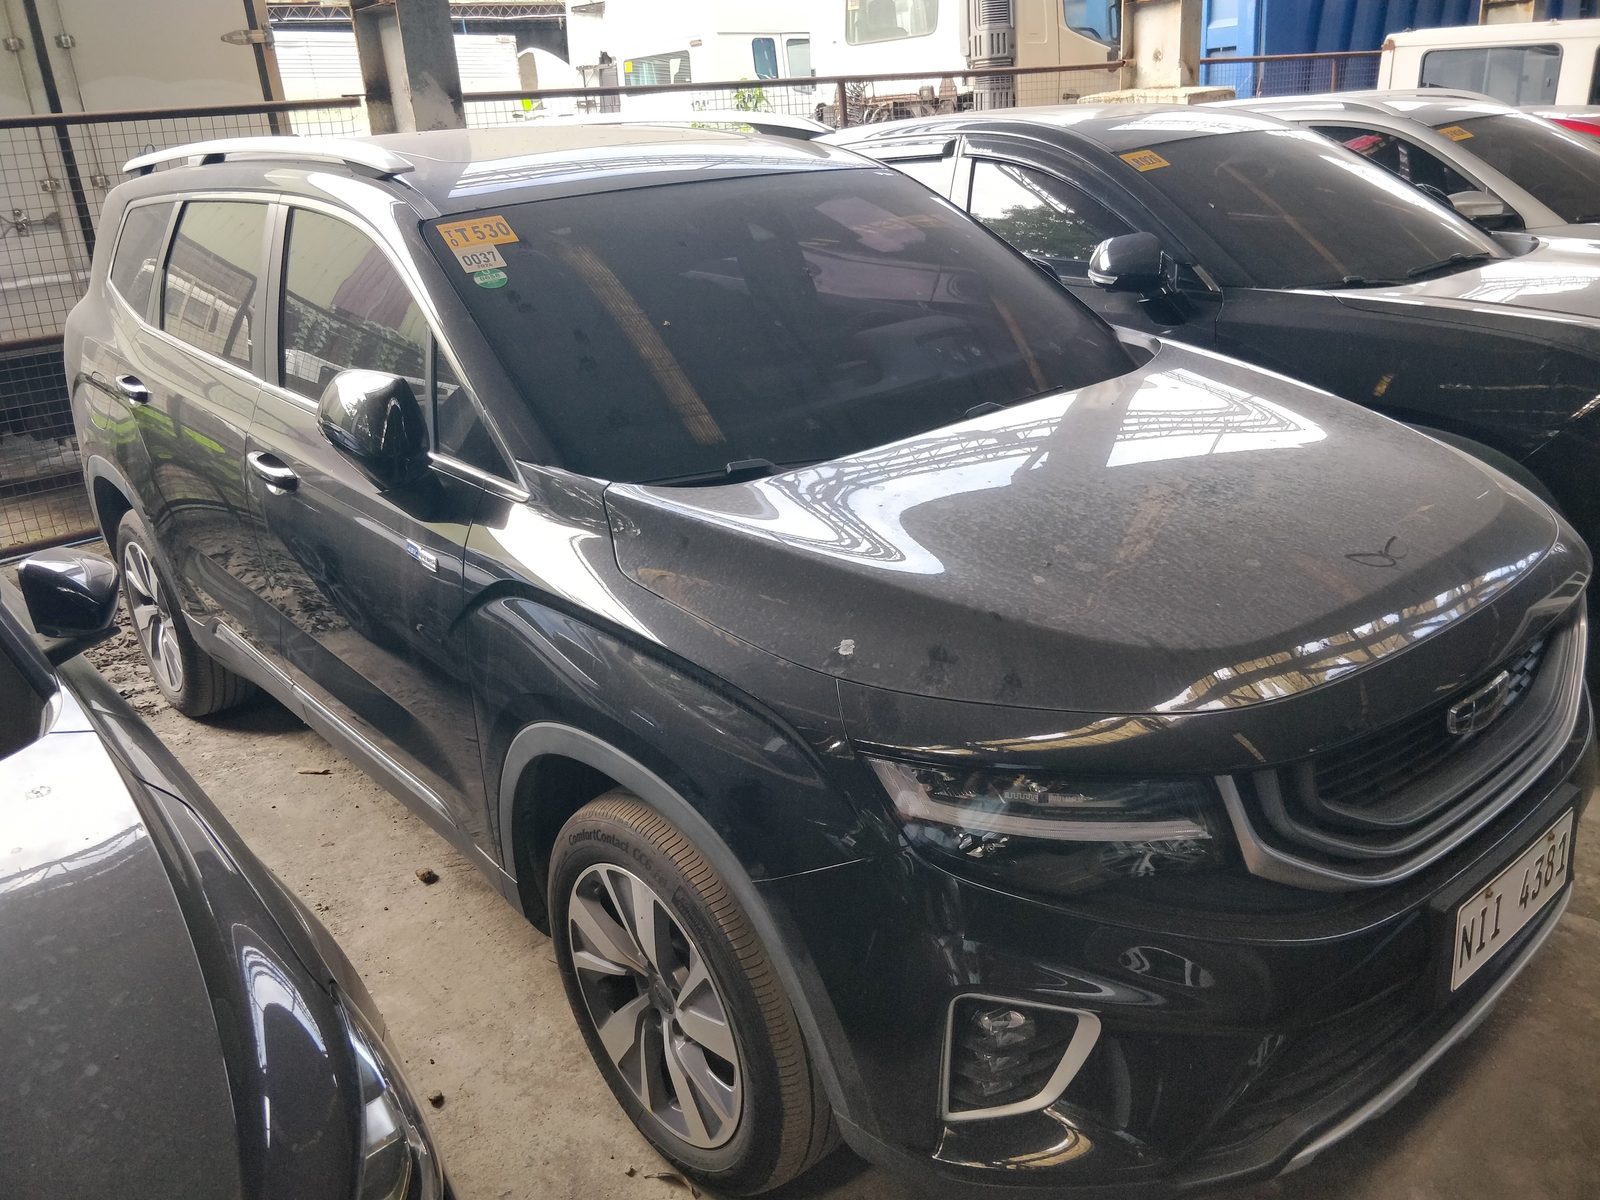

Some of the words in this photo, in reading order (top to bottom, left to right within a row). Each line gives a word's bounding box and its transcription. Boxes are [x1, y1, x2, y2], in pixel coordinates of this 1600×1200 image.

[462, 251, 497, 266] 0037
[568, 828, 630, 852] ComfortContact
[1459, 893, 1503, 969] NII
[1518, 831, 1567, 910] 4381
